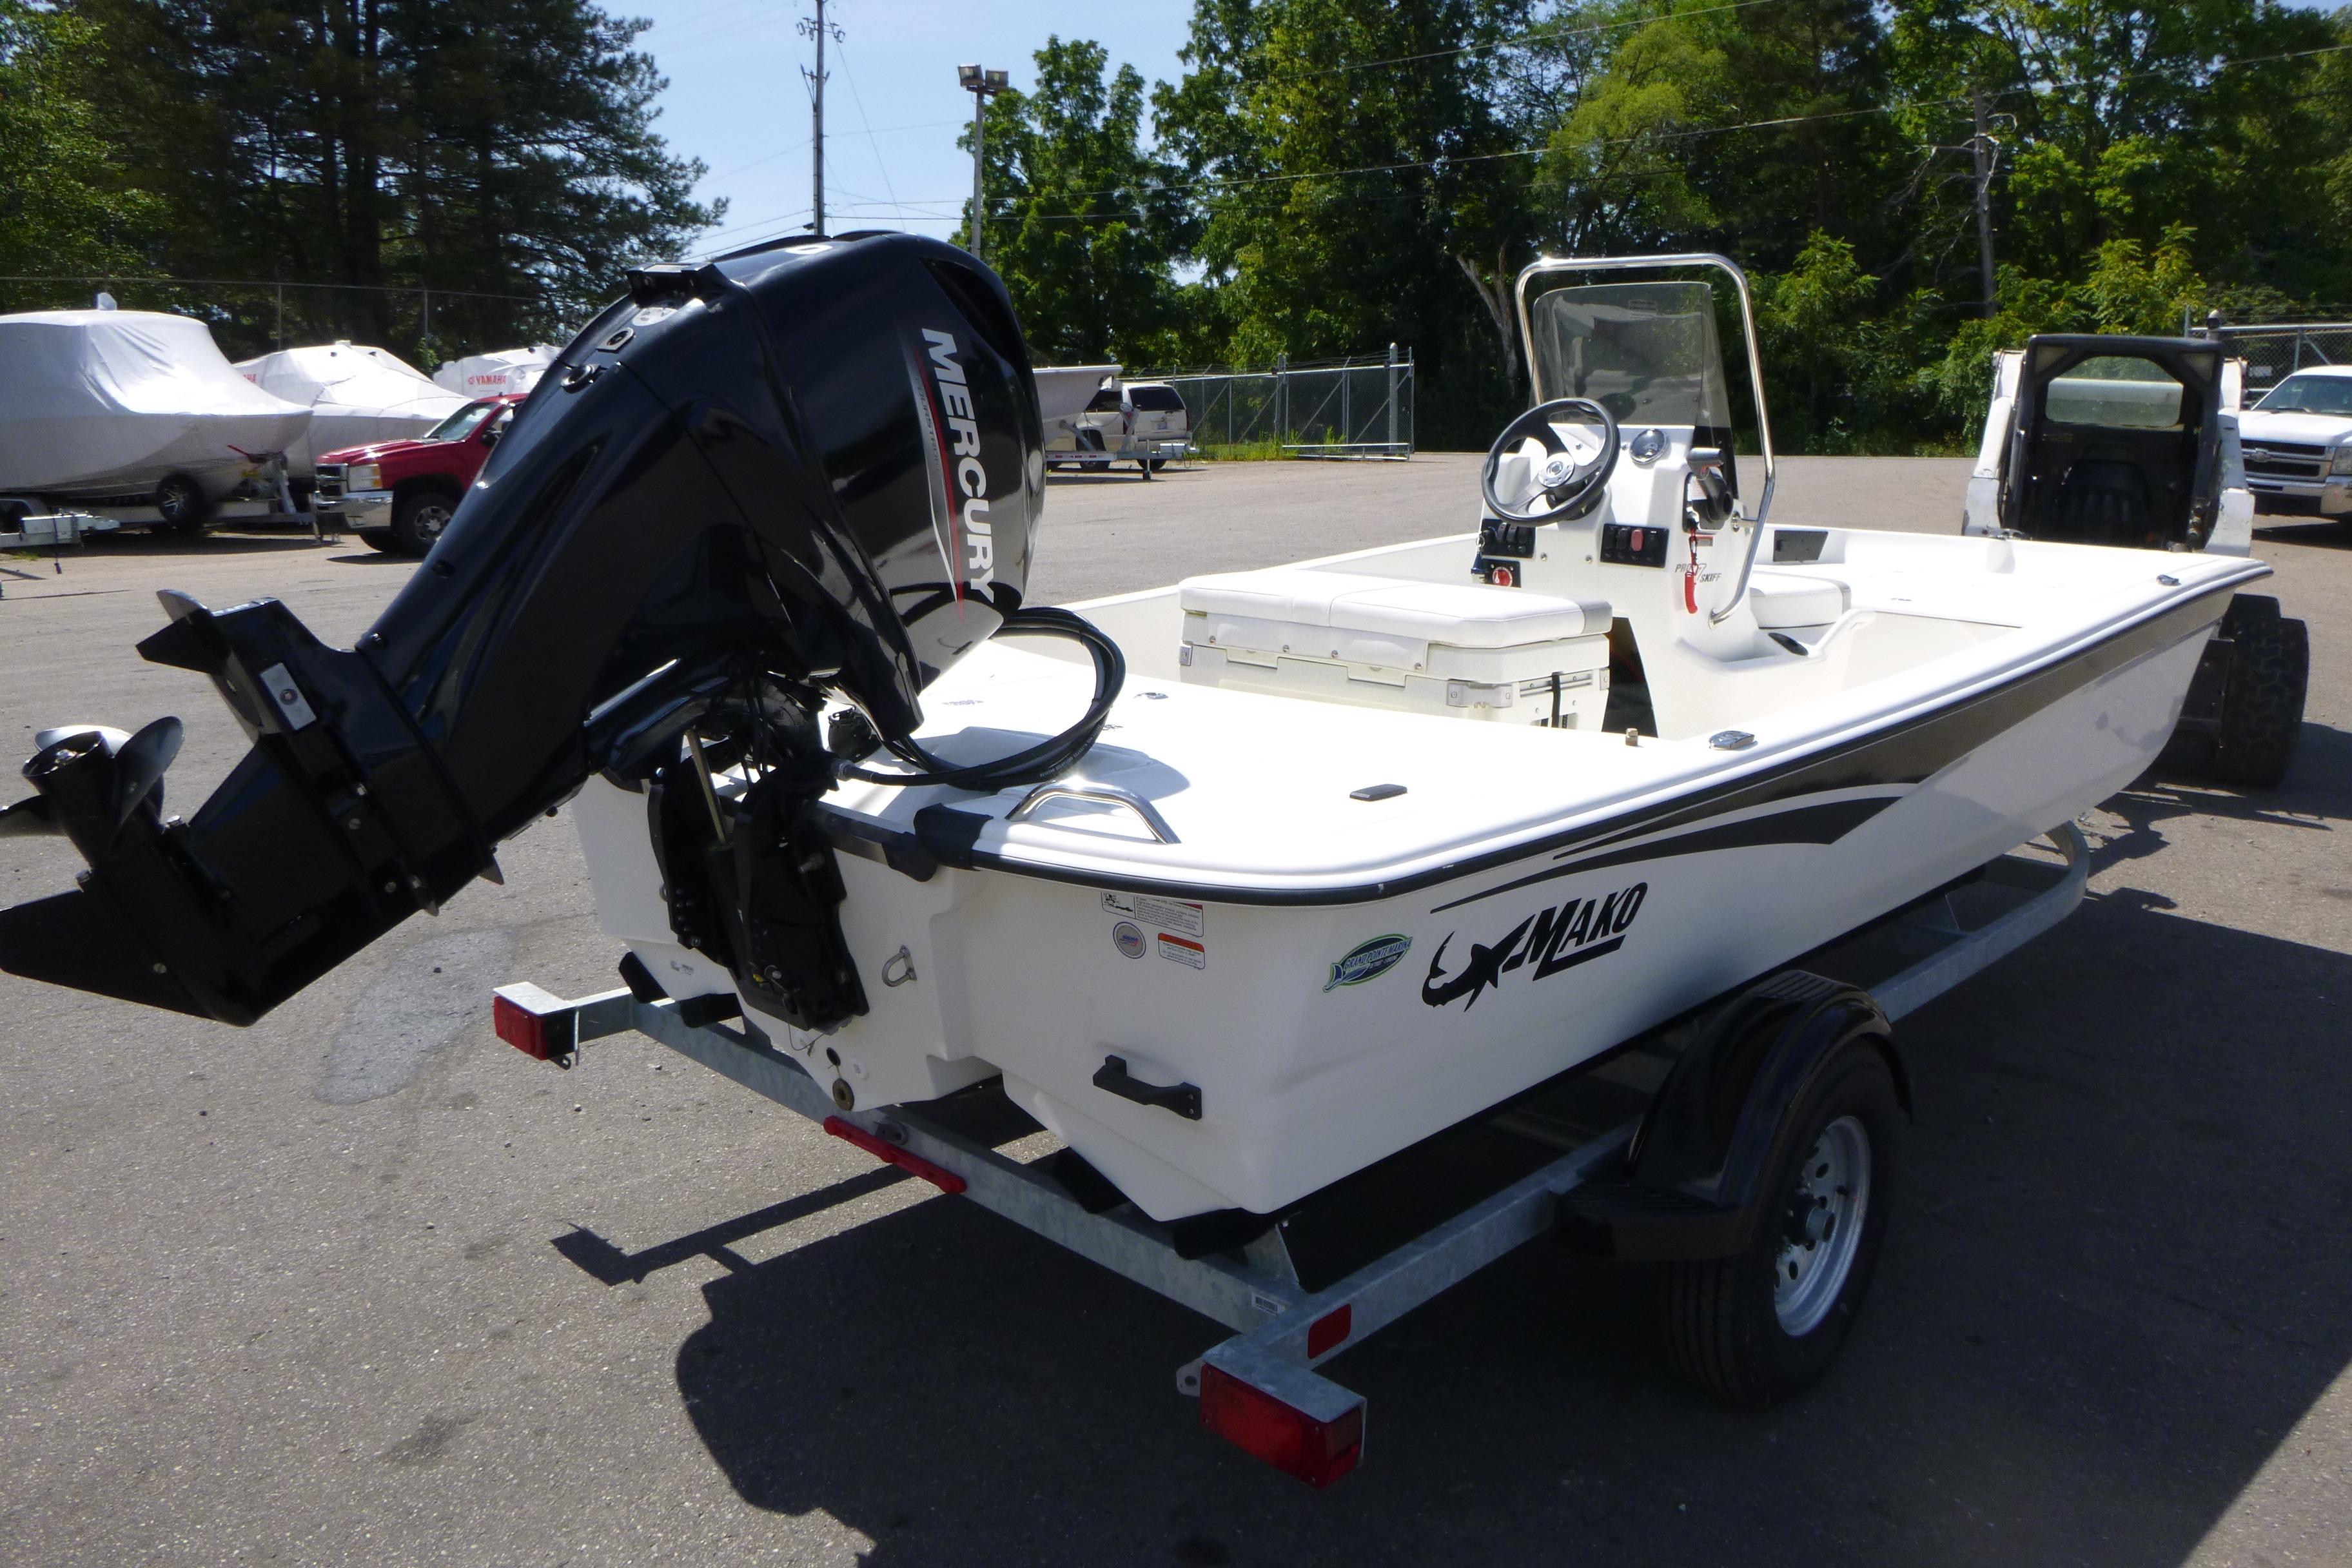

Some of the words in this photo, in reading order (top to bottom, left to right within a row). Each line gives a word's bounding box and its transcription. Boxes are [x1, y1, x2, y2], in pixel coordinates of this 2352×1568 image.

[475, 375, 507, 385] YAMAHA
[921, 328, 995, 603] MERCURY
[1700, 573, 1722, 583] SKIFF
[1502, 882, 1648, 981] MAKO
[1344, 953, 1367, 970] GRAND
[1367, 946, 1389, 962] POINTE
[1389, 937, 1413, 955] MARINA
